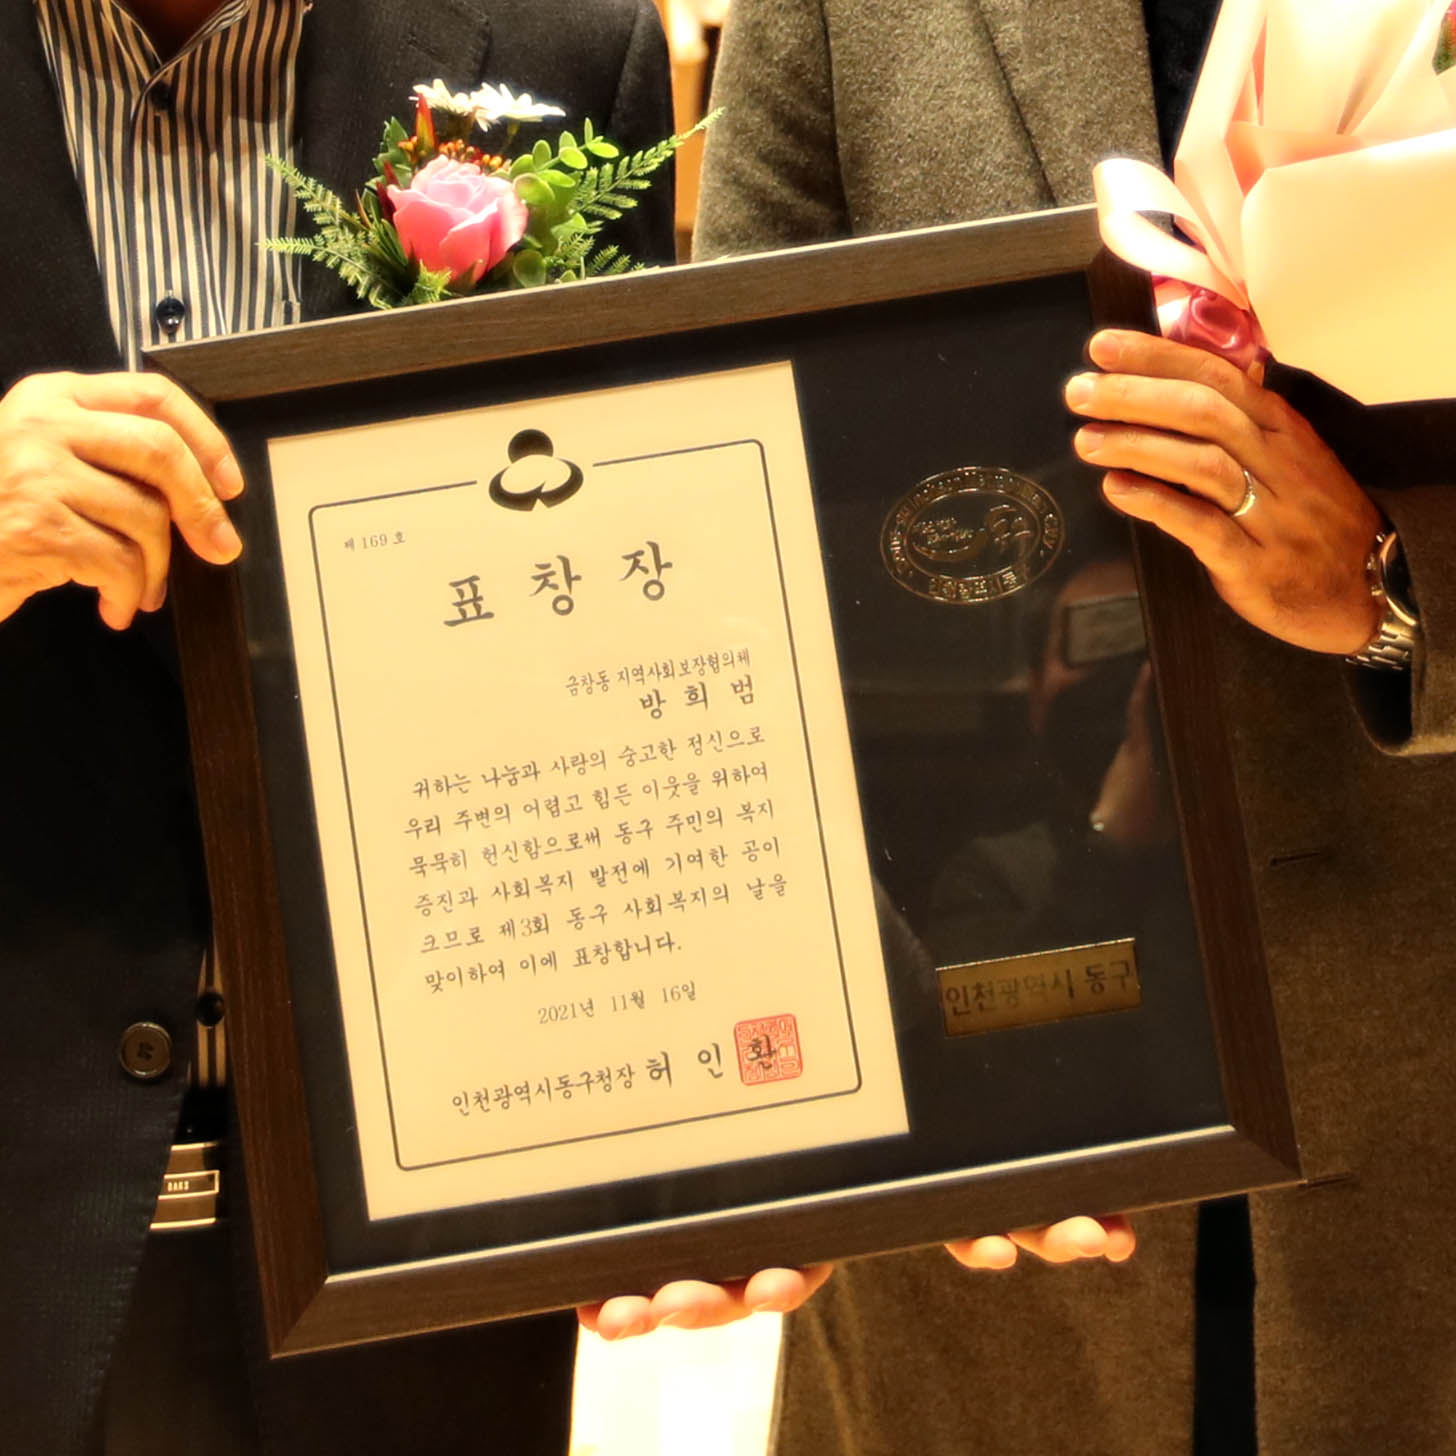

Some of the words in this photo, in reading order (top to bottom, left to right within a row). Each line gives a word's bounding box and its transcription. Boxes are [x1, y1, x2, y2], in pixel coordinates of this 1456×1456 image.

[565, 669, 611, 697] 금창동
[403, 814, 442, 841] 우리
[453, 802, 511, 832] 주변의
[522, 793, 584, 820] 어렵고
[591, 783, 633, 811] 힘든
[641, 771, 701, 801] 이웃을
[711, 760, 768, 789] 위하여
[412, 773, 472, 801] 귀하는
[480, 759, 542, 789] 나눔과
[551, 749, 607, 777] 사랑의
[617, 737, 678, 768] 숭고한
[687, 725, 766, 757] 정신으로
[408, 848, 468, 879] 묵묵히
[481, 826, 601, 867] 헌신함으로써
[614, 818, 654, 846] 동구
[665, 806, 724, 836] 주민의
[735, 797, 774, 824] 복지
[414, 886, 479, 918] 증진과
[491, 869, 574, 903] 사회복지
[588, 856, 650, 889] 발전에
[664, 844, 729, 875] 기여한
[741, 835, 780, 863] 공이
[420, 925, 485, 954] 크므로
[498, 912, 550, 940] 제3회
[566, 903, 608, 931] 동구
[623, 882, 730, 920] 사회복지의
[745, 873, 788, 901] 날을
[424, 959, 506, 995] 맞이하여
[519, 949, 558, 977] 이에
[572, 930, 682, 968] 표창합니다.
[537, 997, 595, 1025] 2021년
[611, 989, 646, 1012] 11월
[661, 980, 697, 1004] 16일
